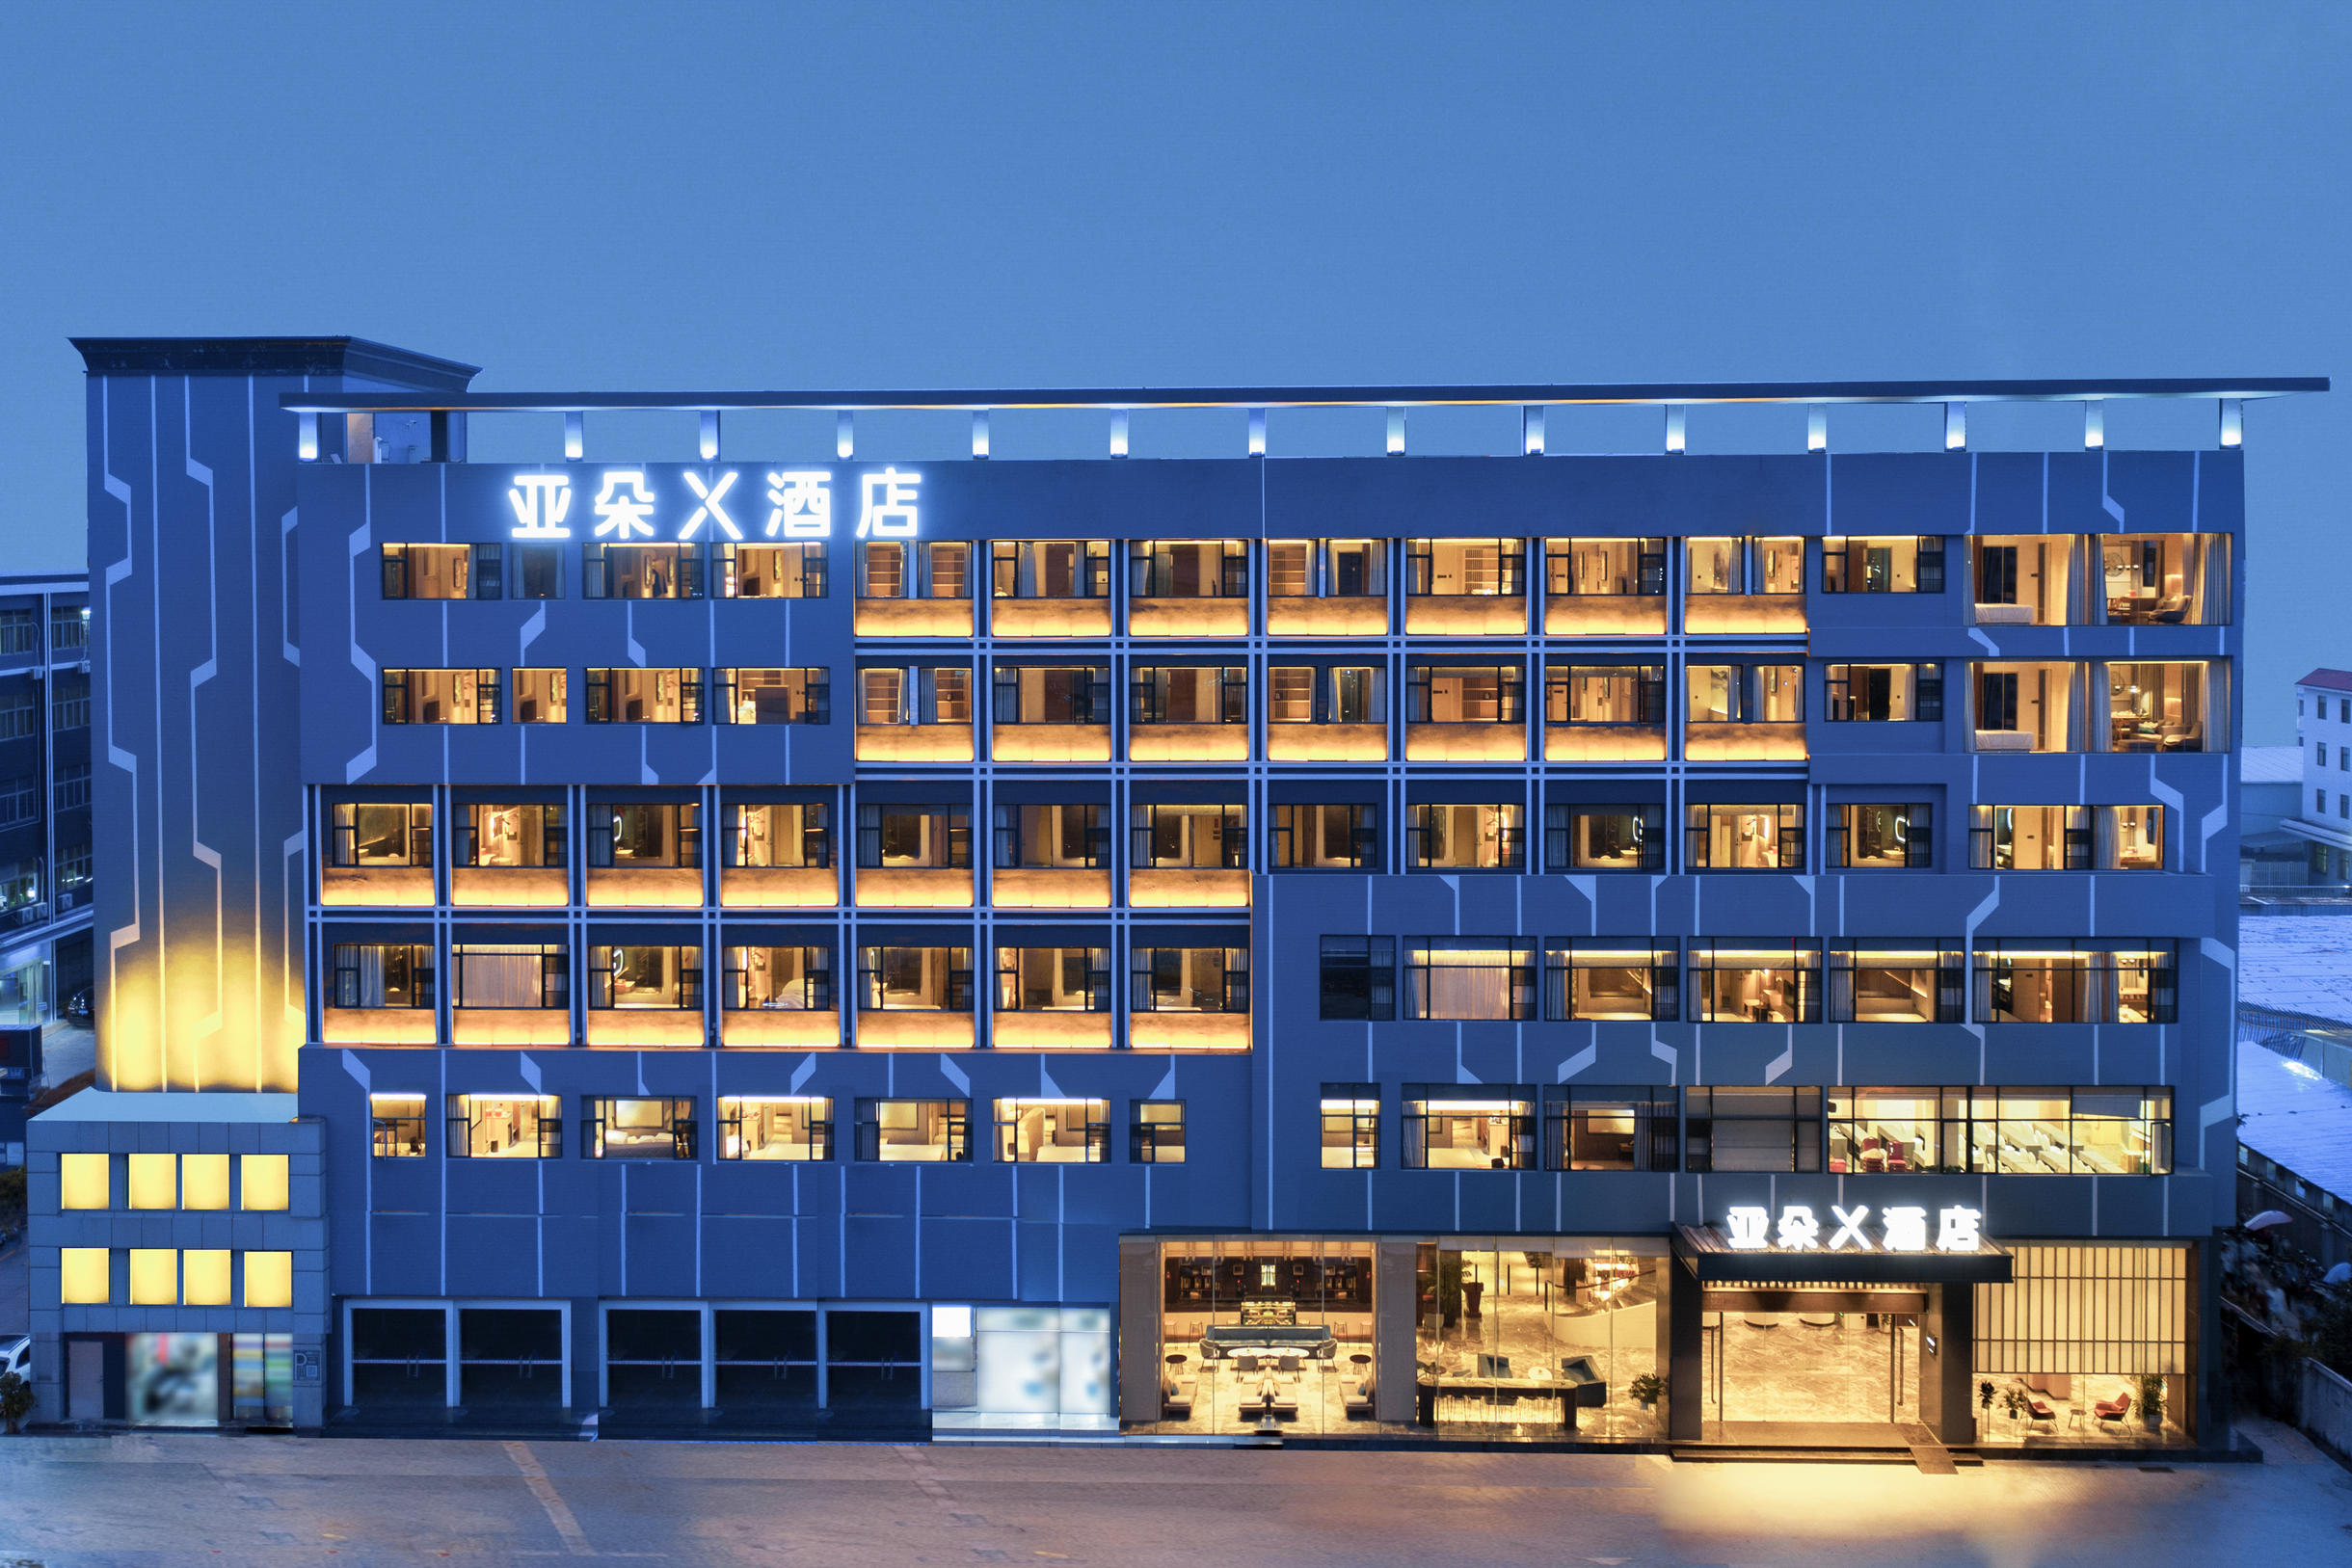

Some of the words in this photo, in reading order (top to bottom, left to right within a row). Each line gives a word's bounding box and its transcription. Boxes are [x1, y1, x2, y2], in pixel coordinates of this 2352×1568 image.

[508, 467, 922, 540] 亚朵X酒店
[1726, 1205, 1982, 1251] 亚朵X酒店
